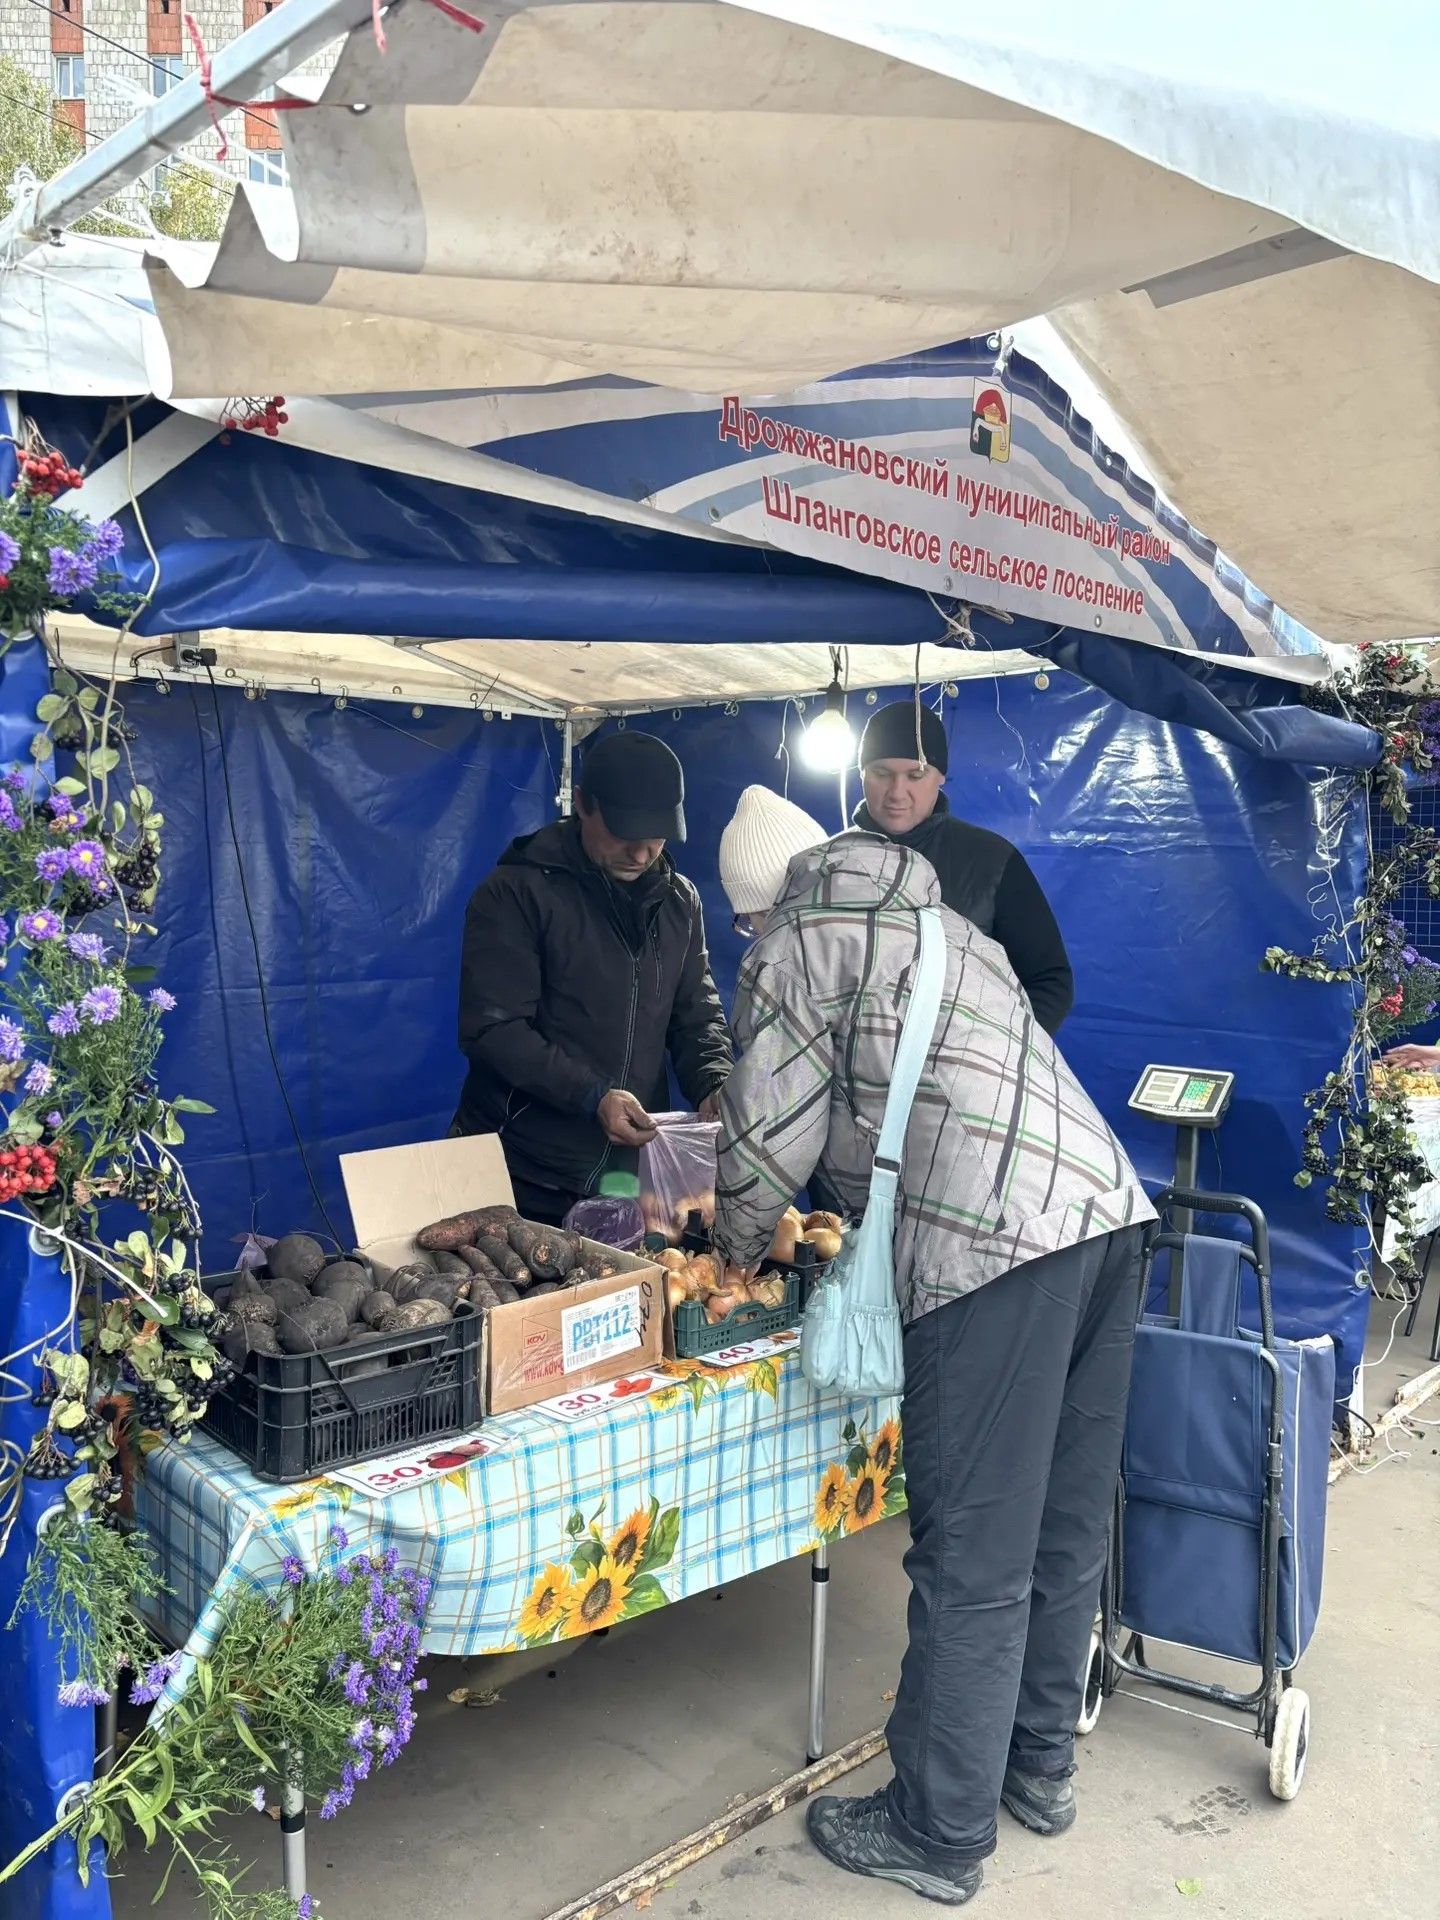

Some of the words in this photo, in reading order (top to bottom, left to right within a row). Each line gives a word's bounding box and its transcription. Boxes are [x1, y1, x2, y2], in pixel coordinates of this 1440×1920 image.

[719, 395, 949, 498] Дрожжановский
[956, 473, 1119, 550] муниципальный
[1120, 526, 1171, 564] район
[761, 475, 942, 564] Шланговское
[949, 540, 1049, 591] сельское
[1052, 567, 1145, 615] поселение
[719, 1346, 754, 1360] 40
[558, 1393, 602, 1410] 30
[367, 1466, 422, 1486] 30
